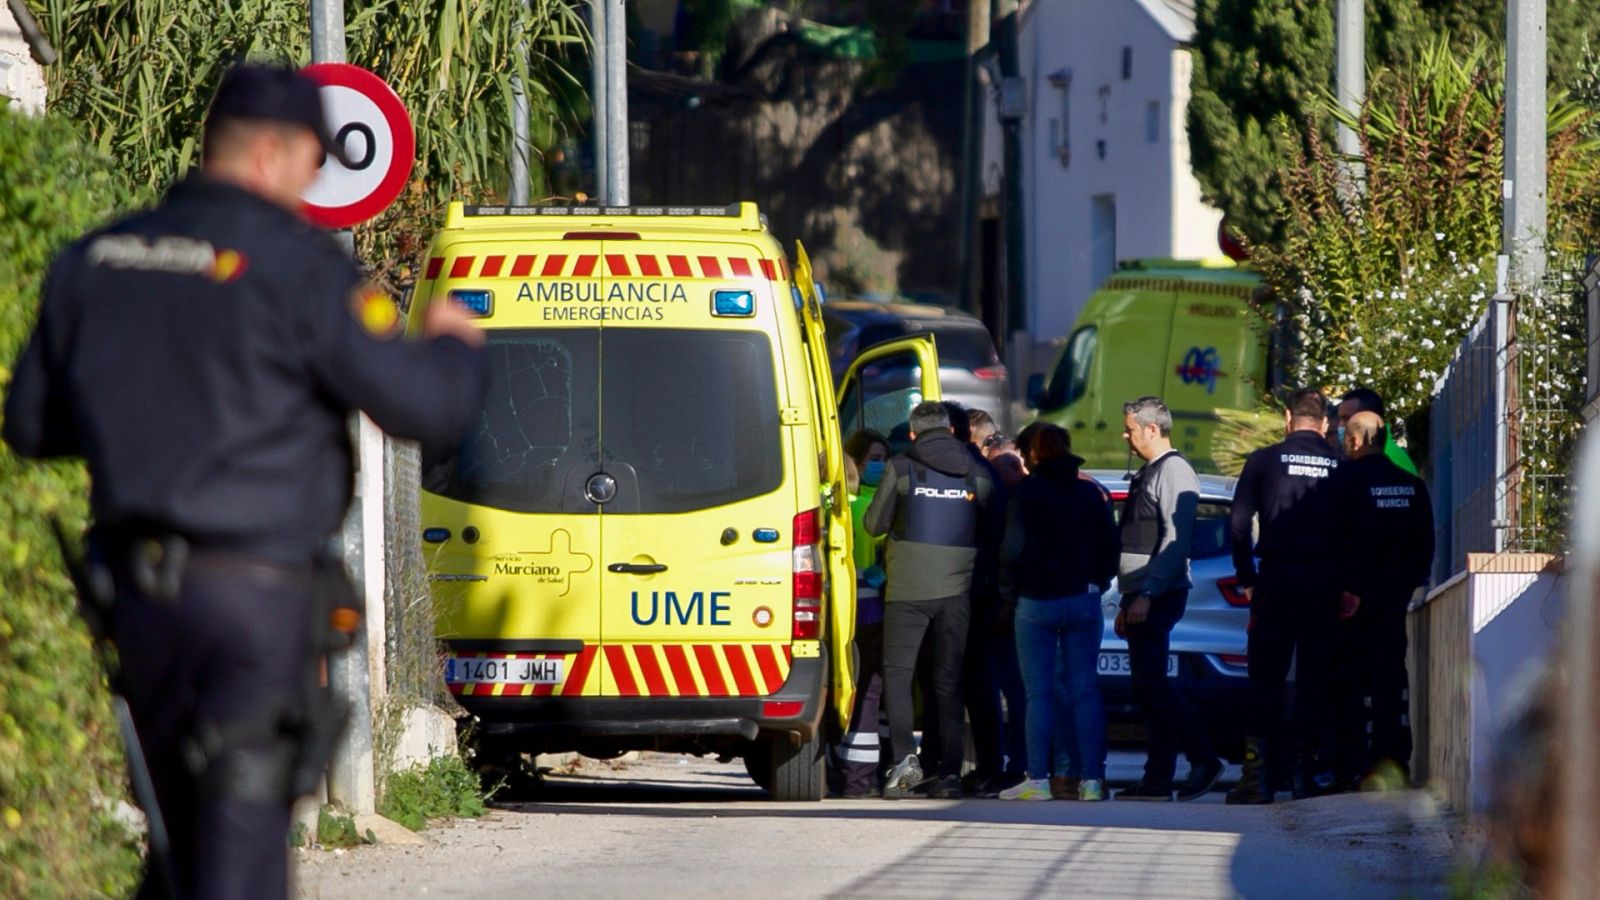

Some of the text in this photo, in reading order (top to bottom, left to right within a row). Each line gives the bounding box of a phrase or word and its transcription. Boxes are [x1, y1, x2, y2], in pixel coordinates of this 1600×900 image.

[516, 282, 688, 303] AMBULANCIA
[542, 306, 664, 321] EMERGENCIAS
[1281, 454, 1338, 468] BOMBEROS
[1288, 464, 1329, 478] MURCIA
[914, 487, 970, 499] POLICIA
[1376, 498, 1410, 508] MURCIA
[494, 562, 560, 575] Murciano
[631, 591, 732, 626] UME
[463, 661, 557, 681] 1401 JMH
